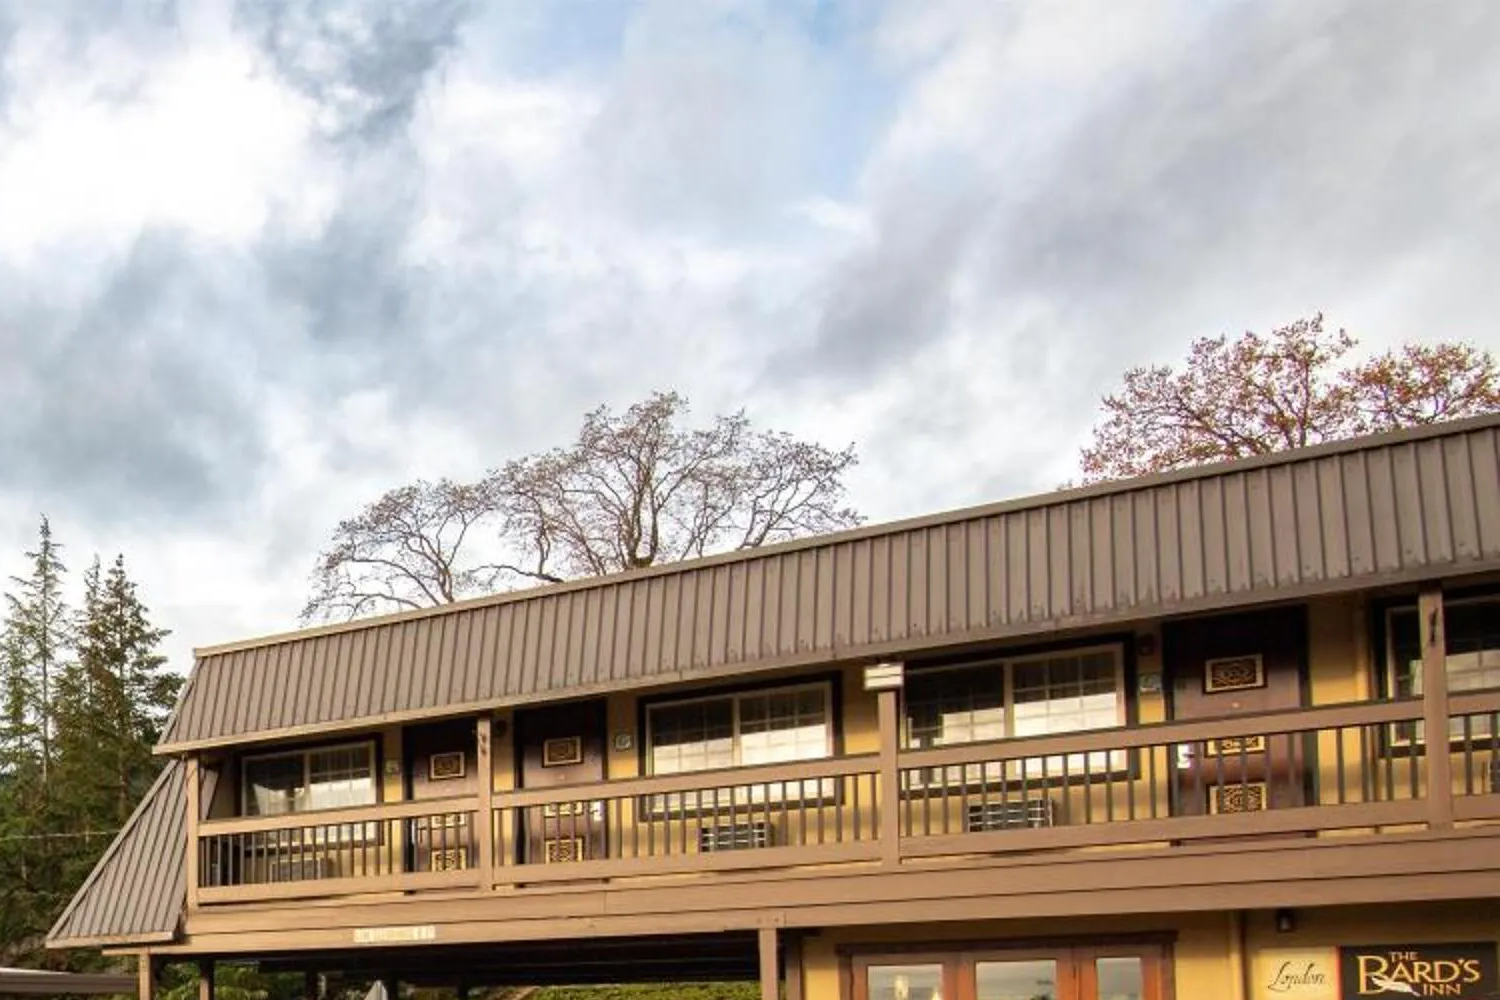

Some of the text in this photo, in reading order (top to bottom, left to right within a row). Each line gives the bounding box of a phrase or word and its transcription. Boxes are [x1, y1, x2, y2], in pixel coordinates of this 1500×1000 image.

[1388, 951, 1419, 963] THE
[1267, 961, 1326, 993] London
[1357, 955, 1481, 995] BARD'S
[1423, 983, 1461, 996] INN
